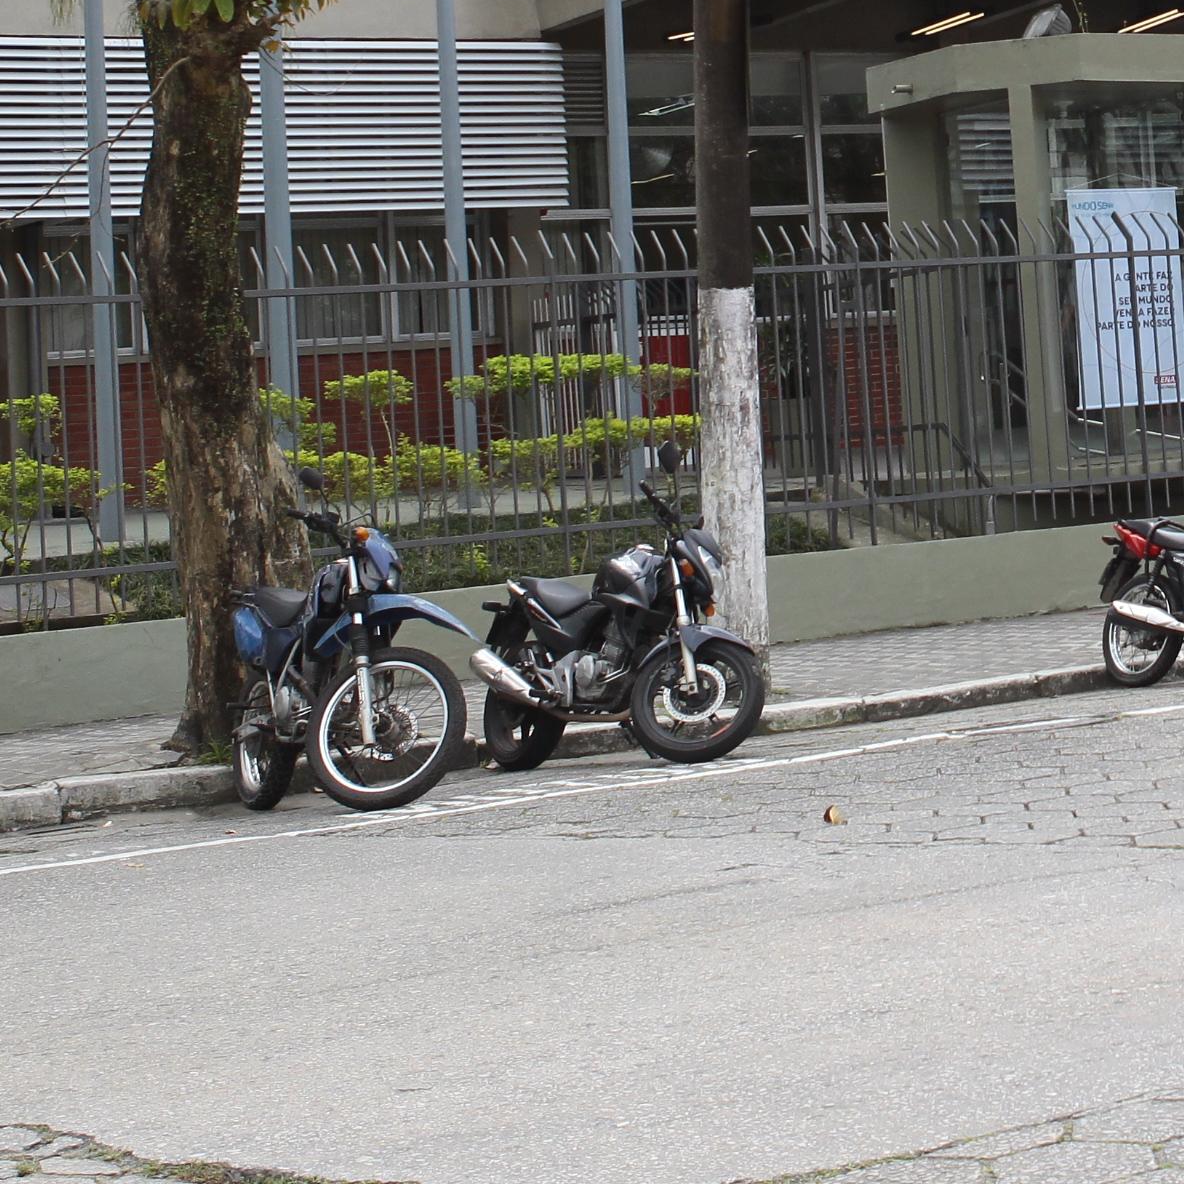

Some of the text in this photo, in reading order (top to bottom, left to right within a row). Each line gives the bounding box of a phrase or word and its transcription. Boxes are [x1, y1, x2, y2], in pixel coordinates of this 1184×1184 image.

[1115, 273, 1122, 282] A
[1123, 272, 1153, 282] GNT
[1133, 283, 1158, 292] ARTE
[1119, 297, 1135, 305] SE
[1114, 306, 1174, 317] ENA FAZE
